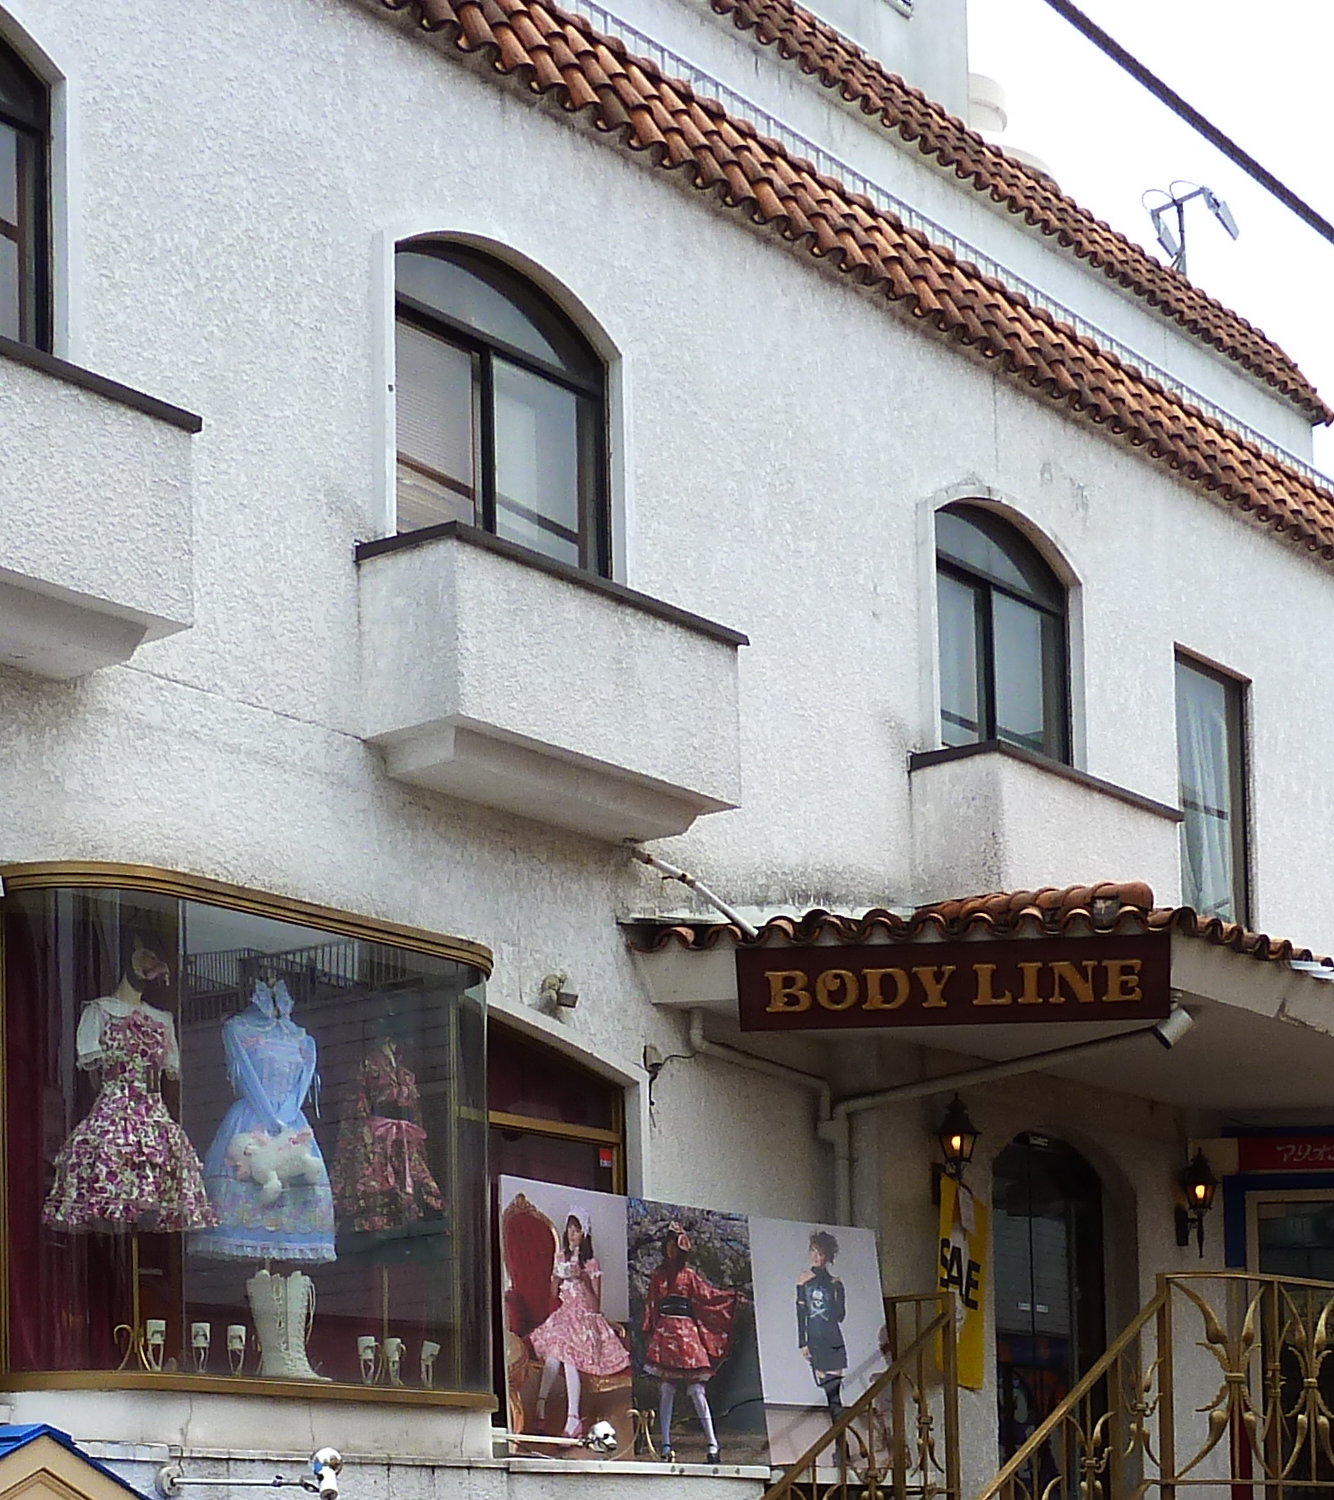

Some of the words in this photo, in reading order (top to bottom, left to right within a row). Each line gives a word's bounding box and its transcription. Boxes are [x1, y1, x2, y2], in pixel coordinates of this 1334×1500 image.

[764, 965, 956, 1013] BODY
[972, 958, 1143, 1006] LINE
[939, 1238, 980, 1310] SAE
